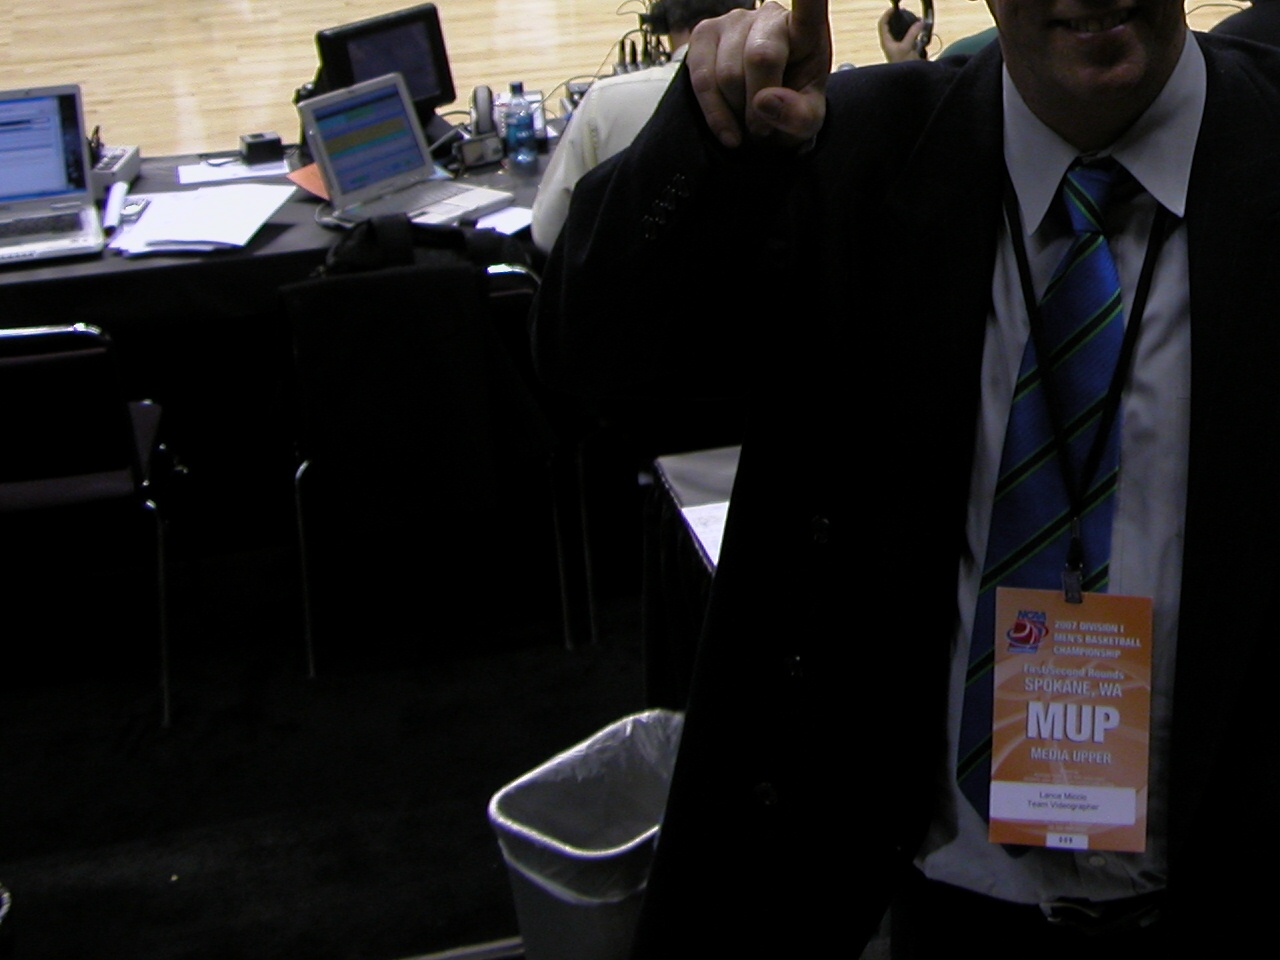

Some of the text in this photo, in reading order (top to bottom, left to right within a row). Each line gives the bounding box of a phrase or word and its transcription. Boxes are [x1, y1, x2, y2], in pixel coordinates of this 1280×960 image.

[1054, 621, 1078, 631] 2007
[1079, 622, 1118, 633] DIVISION
[1053, 633, 1142, 648] MEN'S BASKETBALL
[1053, 646, 1121, 659] CHAMPIONSHIP
[1087, 669, 1125, 680] Rounds
[1024, 678, 1122, 698] SPOKANE, WA
[1026, 701, 1121, 744] MUP
[1030, 747, 1112, 765] MEDIA UPPER
[1027, 800, 1049, 808] Team
